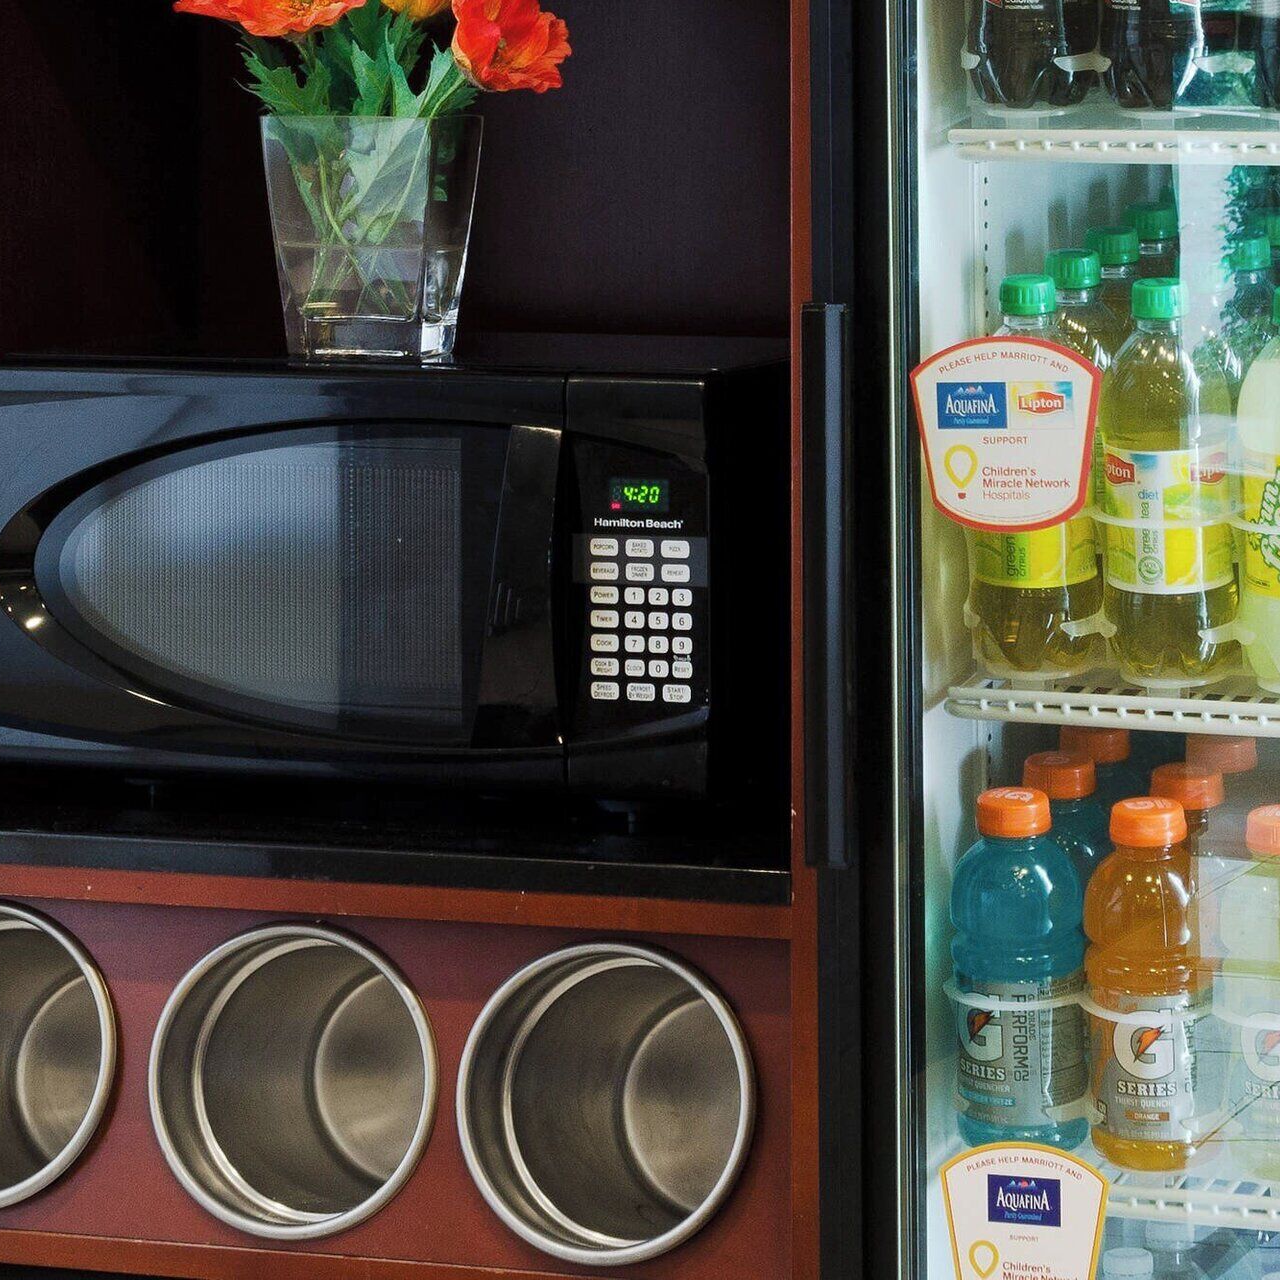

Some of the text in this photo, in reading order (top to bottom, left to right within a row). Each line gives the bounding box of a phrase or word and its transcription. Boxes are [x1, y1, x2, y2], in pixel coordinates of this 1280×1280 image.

[939, 352, 1069, 374] PLEASE HELP MARRIOTT AND
[946, 393, 997, 415] AQUAFINA
[1021, 397, 1062, 409] Lipton
[982, 436, 1028, 444] SUPPORT
[982, 467, 1036, 476] Children's
[982, 479, 1070, 488] Miracle Network
[624, 486, 660, 503] 4:20
[983, 492, 1030, 501] Hospitals
[1138, 488, 1159, 500] diet
[1141, 502, 1150, 518] tea
[594, 518, 681, 529] Hamilton Beach
[1006, 536, 1016, 577] green
[632, 592, 636, 600] 1
[655, 593, 661, 601] 2
[679, 594, 685, 602] 3
[631, 616, 637, 624] 4
[655, 617, 661, 625] 5
[679, 618, 685, 626] 6
[596, 639, 613, 647] COOK
[632, 640, 637, 648] 7
[655, 641, 661, 649] 8
[679, 642, 685, 650] 9
[655, 665, 661, 673] 0
[1113, 1009, 1175, 1079] G
[960, 1060, 1006, 1081] SERIES
[1117, 1081, 1177, 1096] SERIES
[1134, 1113, 1160, 1121] ORANGE
[967, 1158, 996, 1172] PLEASE
[1022, 1157, 1063, 1170] MARRIOTT
[1066, 1169, 1082, 1180] AND
[996, 1187, 1050, 1210] AQUAFINA
[1003, 1262, 1050, 1273] Children's
